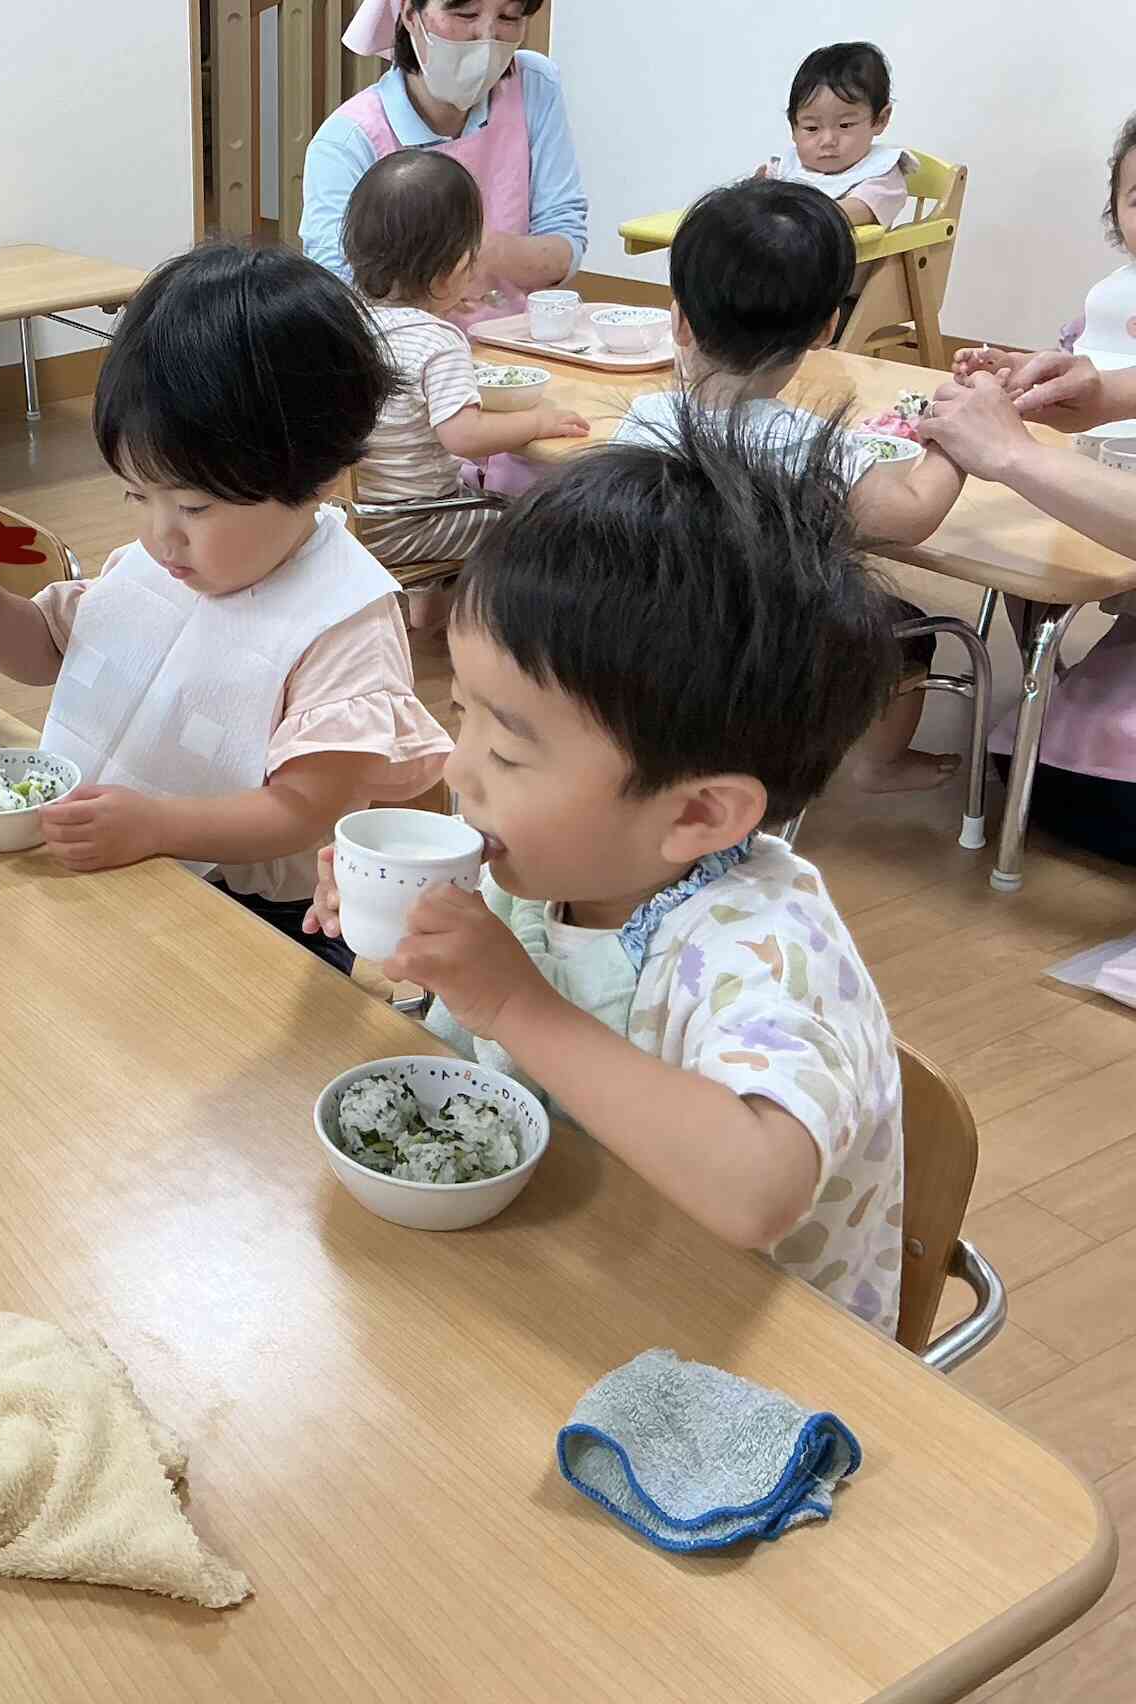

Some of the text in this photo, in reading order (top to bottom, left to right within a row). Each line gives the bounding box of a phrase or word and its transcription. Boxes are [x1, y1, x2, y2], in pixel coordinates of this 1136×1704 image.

[441, 1069, 450, 1080] A
[481, 1081, 490, 1092] C
[502, 1088, 510, 1100] D
